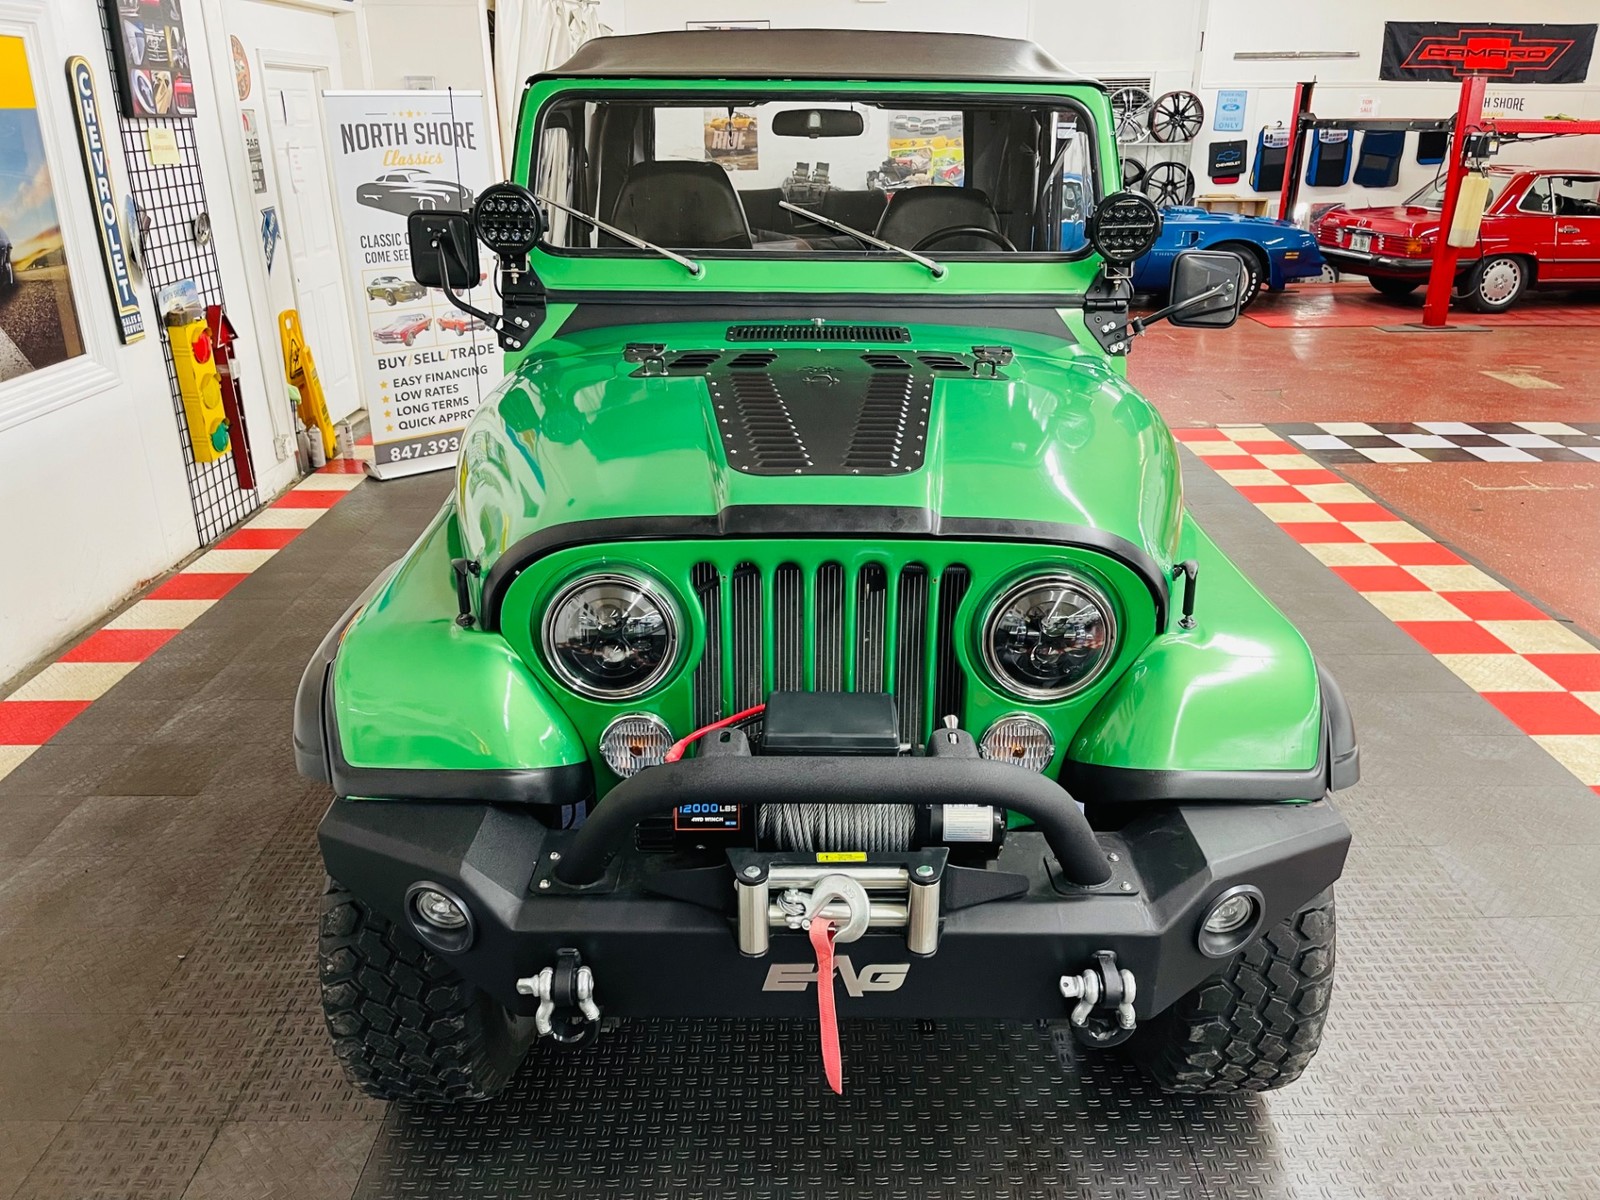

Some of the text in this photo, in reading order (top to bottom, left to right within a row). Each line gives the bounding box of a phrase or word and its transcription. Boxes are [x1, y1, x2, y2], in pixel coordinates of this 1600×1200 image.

[1427, 48, 1546, 58] CAMARO
[1493, 97, 1525, 111] SHORE
[340, 121, 477, 154] NORTH SHORE
[711, 130, 746, 150] RIDE
[382, 149, 445, 167] Classics
[1215, 160, 1241, 168] CHEVROLET
[79, 71, 130, 301] CHEVROLET
[360, 232, 402, 249] CLASSIC
[365, 249, 410, 264] COME SEE
[393, 365, 488, 389] EASY FINANCING
[395, 384, 459, 403] LOW RATES
[397, 396, 469, 417] LONG TERMS
[399, 409, 475, 430] QUICK APPRO
[390, 436, 459, 462] 847.393
